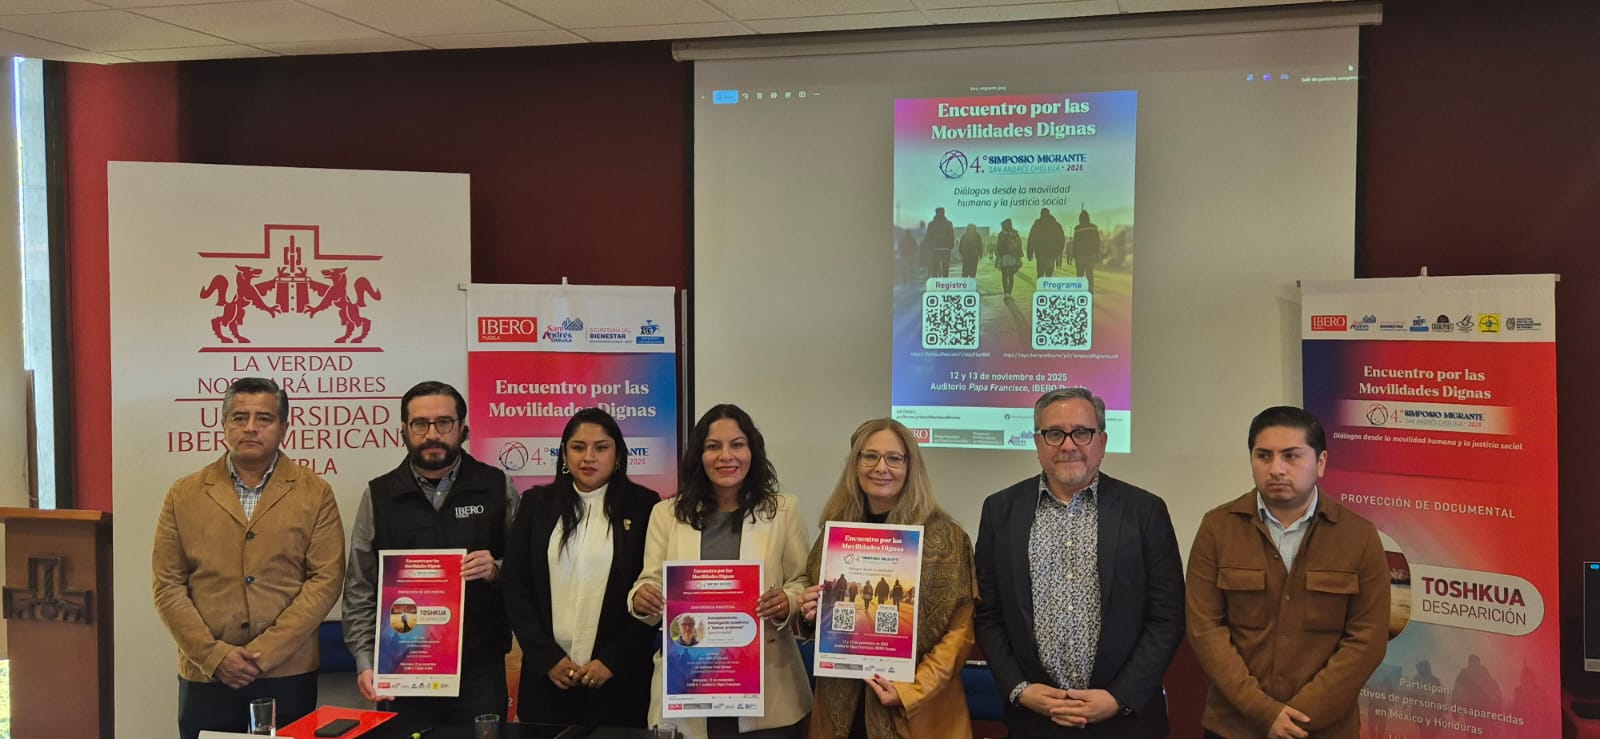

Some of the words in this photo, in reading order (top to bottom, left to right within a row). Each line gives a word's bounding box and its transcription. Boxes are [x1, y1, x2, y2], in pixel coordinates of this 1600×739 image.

[938, 102, 1027, 118] Encuentro
[1030, 103, 1061, 118] por
[1064, 98, 1090, 114] las
[931, 123, 1032, 140] Movilidades
[1036, 122, 1096, 140] Dignas
[988, 154, 1034, 164] SIMPOSIO
[1037, 153, 1088, 163] MIGRANTE
[954, 186, 990, 197] Diálogos
[992, 186, 1017, 195] desde
[1018, 186, 1027, 194] la
[1028, 184, 1071, 194] movilidad
[957, 198, 992, 207] humana
[994, 199, 998, 208] y
[1000, 198, 1008, 206] la
[1009, 198, 1039, 208] justicia
[1041, 197, 1067, 206] social
[935, 281, 968, 292] Registro
[1042, 281, 1082, 292] Programa
[482, 320, 534, 335] IBERO
[1313, 316, 1346, 326] IBERO
[233, 356, 260, 372] LA
[267, 356, 353, 372] VERDAD
[950, 372, 959, 380] 12
[961, 373, 967, 382] y
[968, 372, 978, 381] 13
[980, 372, 990, 381] de
[992, 372, 1033, 382] noviembre
[1036, 372, 1046, 381] de
[1048, 372, 1068, 382] 2025
[1364, 366, 1434, 380] Encuentro
[1437, 370, 1462, 382] por
[1465, 368, 1486, 381] las
[318, 376, 386, 392] LIBRES
[495, 380, 586, 395] Encuentro
[590, 382, 622, 398] por
[624, 380, 649, 395] las
[930, 382, 967, 392] Auditorio
[968, 383, 988, 393] Papa
[990, 383, 1030, 394] Francisco,
[1032, 385, 1056, 393] IBERO
[1359, 383, 1440, 398] Movilidades
[1442, 386, 1492, 400] Dignas
[201, 405, 390, 428] URSIDAD
[1404, 410, 1442, 418] SIMPOSIO
[1444, 412, 1485, 421] MIGRANTE
[168, 428, 406, 452] IBERMERICAN
[1333, 432, 1362, 440] Diálogos
[1363, 433, 1383, 442] desde
[1384, 434, 1391, 442] la
[1393, 435, 1426, 444] movilidad
[1428, 438, 1456, 446] humana
[1472, 440, 1499, 450] justicia
[1500, 442, 1522, 450] social
[455, 504, 484, 515] IBERO
[1340, 493, 1411, 509] PROYECCIÓN
[1415, 501, 1430, 511] DE
[1435, 502, 1516, 519] DOCUMENTAL
[1420, 576, 1526, 607] TOSHKUA
[1422, 599, 1526, 626] DESAPARICIÓN
[1388, 694, 1400, 703] de
[1403, 696, 1448, 711] personas
[1451, 704, 1524, 726] desaparecidas
[1376, 708, 1386, 717] en
[1389, 709, 1423, 724] México
[1425, 718, 1431, 727] y
[1434, 718, 1482, 735] Honduras
